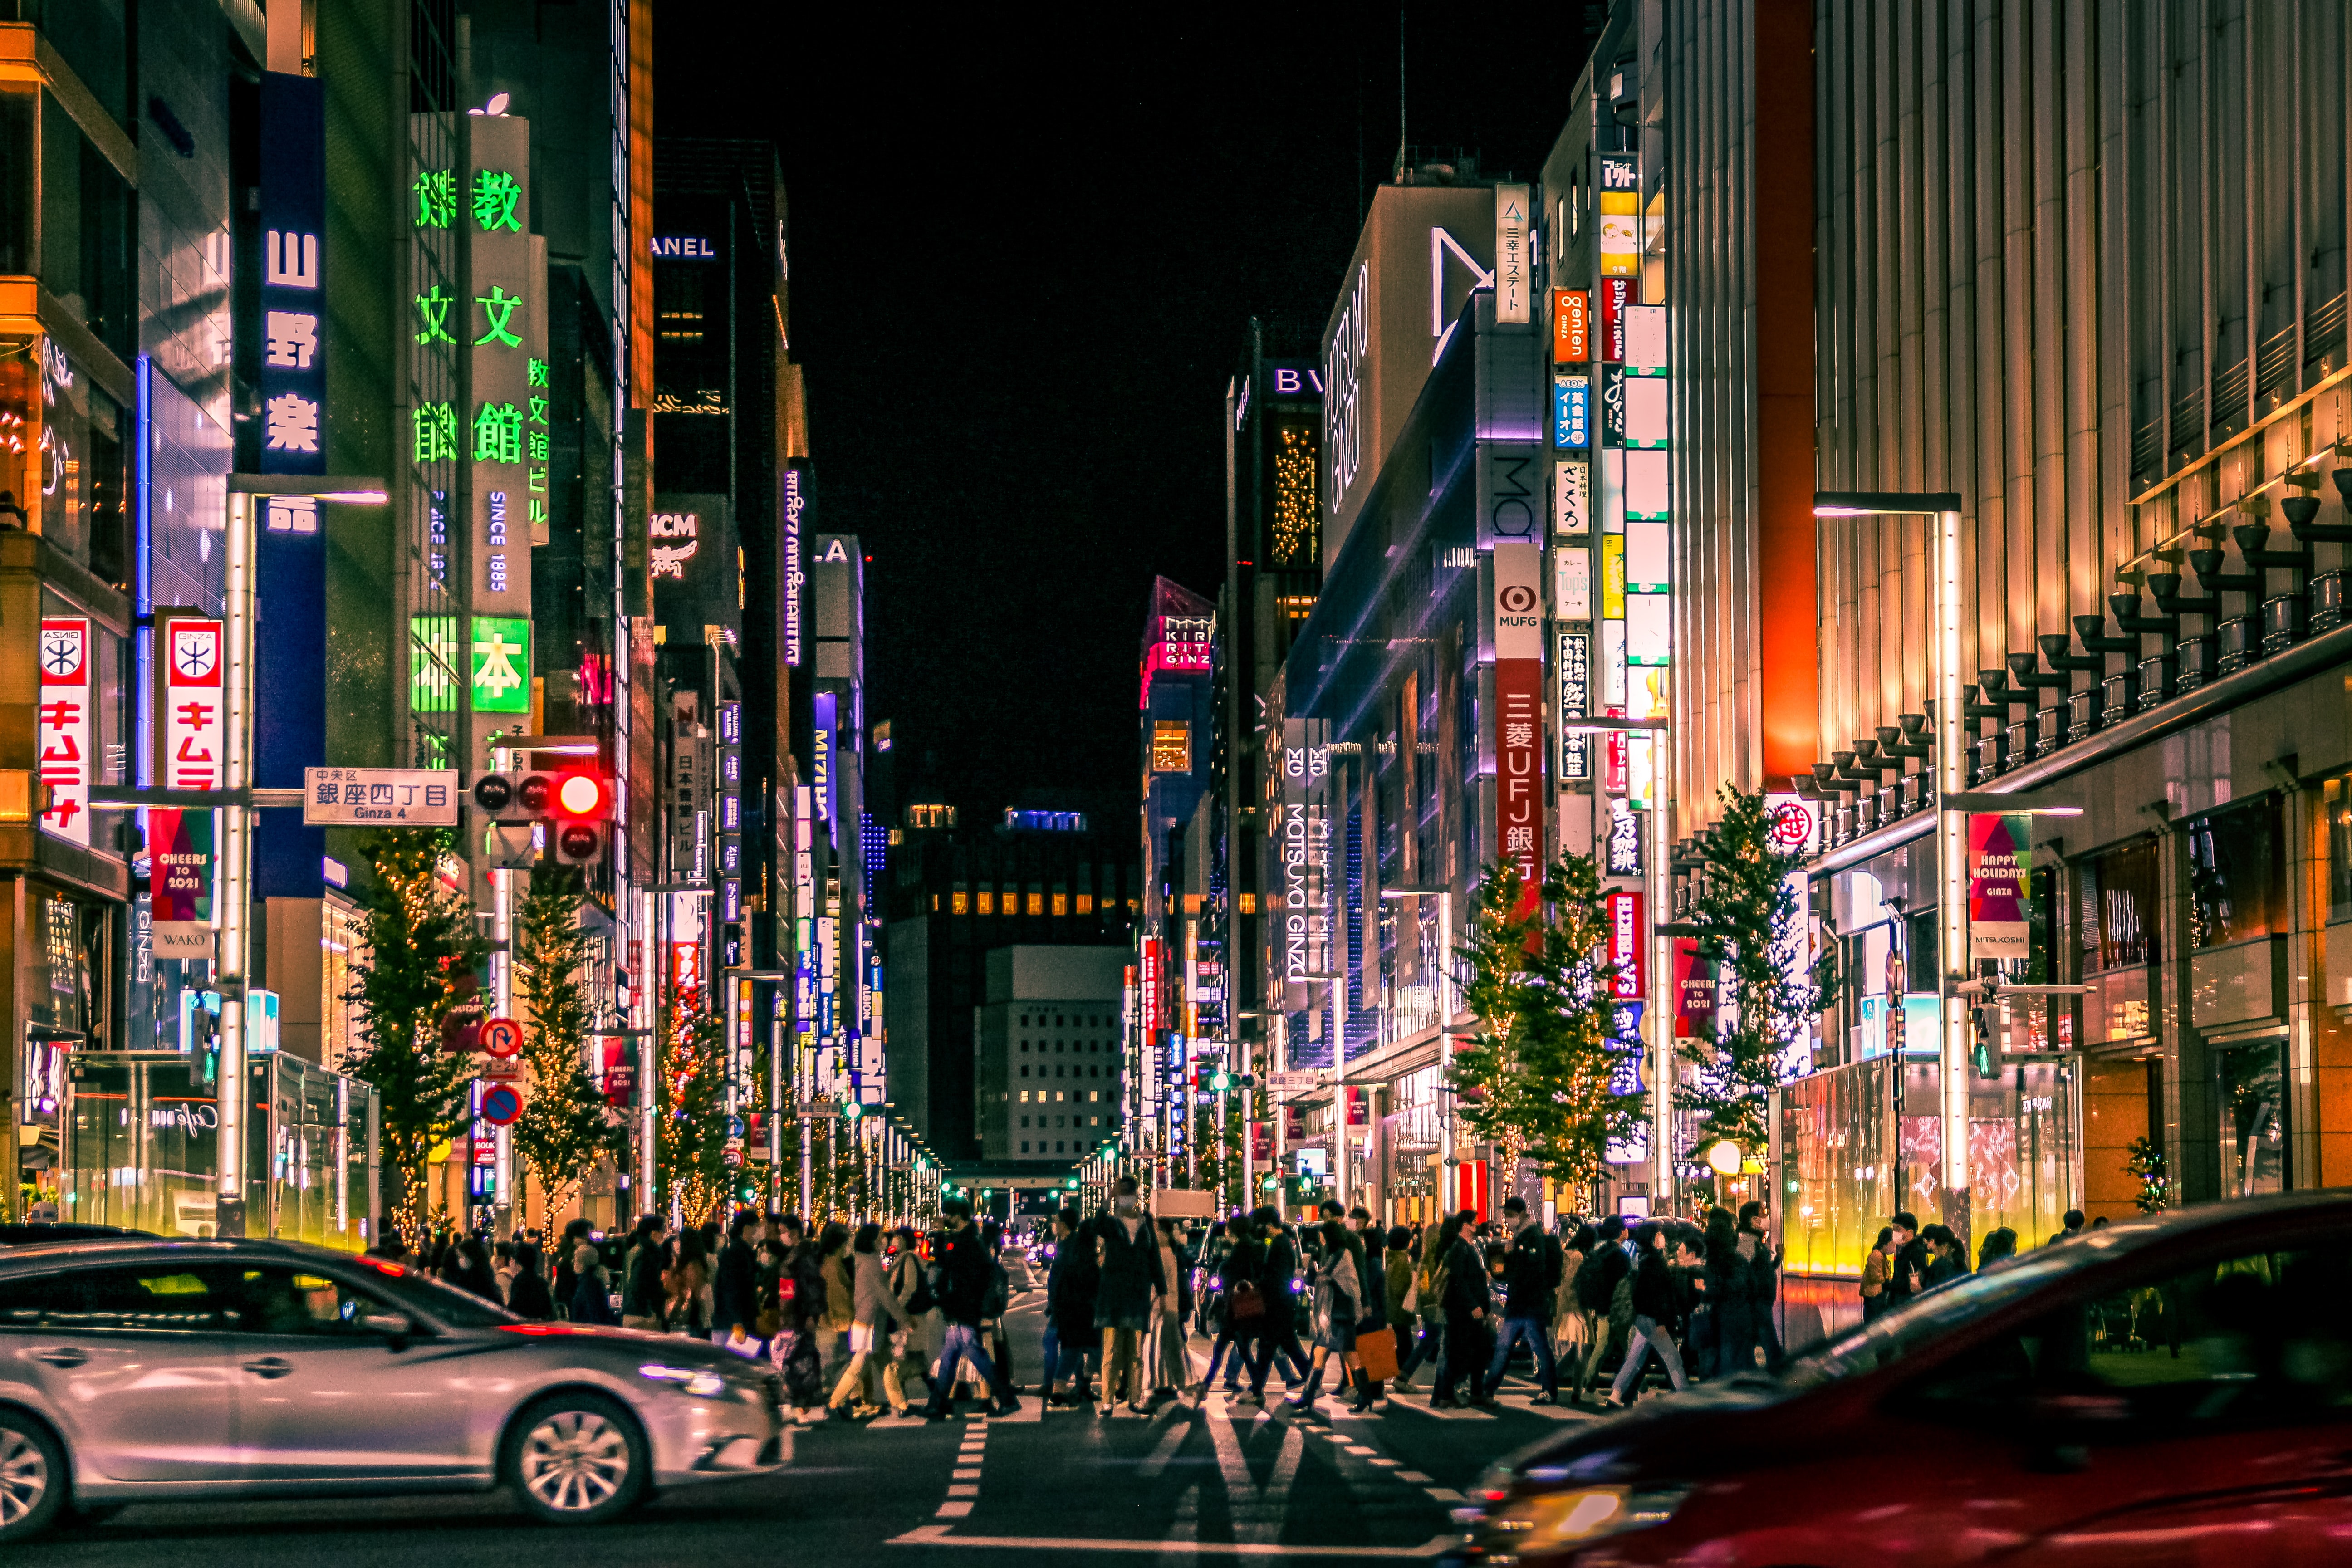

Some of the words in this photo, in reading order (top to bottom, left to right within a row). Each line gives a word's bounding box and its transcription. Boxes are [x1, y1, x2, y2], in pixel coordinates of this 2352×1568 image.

[651, 237, 715, 256] ANEL
[1505, 227, 1520, 311] 三幸エステート
[472, 168, 523, 464] 教文館
[1560, 379, 1584, 388] AEON
[1572, 392, 1584, 430] 英会話
[1559, 392, 1571, 443] イーオン
[529, 357, 549, 525] 教文館ビル
[1573, 433, 1583, 442] 3F
[1579, 466, 1588, 498] 日本料理
[1563, 466, 1578, 528] ざくろ
[490, 491, 507, 546] SINCE
[651, 514, 696, 537] CM
[490, 554, 507, 593] 1885
[1500, 616, 1537, 627] MUFG
[179, 632, 213, 641] GINZA
[1562, 637, 1574, 681] 中国料理
[474, 633, 522, 698] 本
[316, 770, 357, 781] 中央区
[316, 784, 446, 806] 銀座四丁目
[354, 807, 394, 819] Ginza
[397, 807, 406, 818] 4
[159, 853, 207, 865] CHEERS
[1981, 855, 2018, 867] HAPPY
[176, 867, 190, 875] TO
[1632, 867, 1642, 876] 2F
[1973, 868, 2027, 879] HOLIDAYS
[168, 877, 199, 889] 2021
[1986, 887, 2012, 896] GINZA
[163, 933, 206, 946] WAKO
[1975, 936, 2025, 944] MITSUKOSHI
[1680, 980, 1716, 990] CHEERS
[862, 984, 872, 1020] ALBION
[1687, 999, 1710, 1009] 2021
